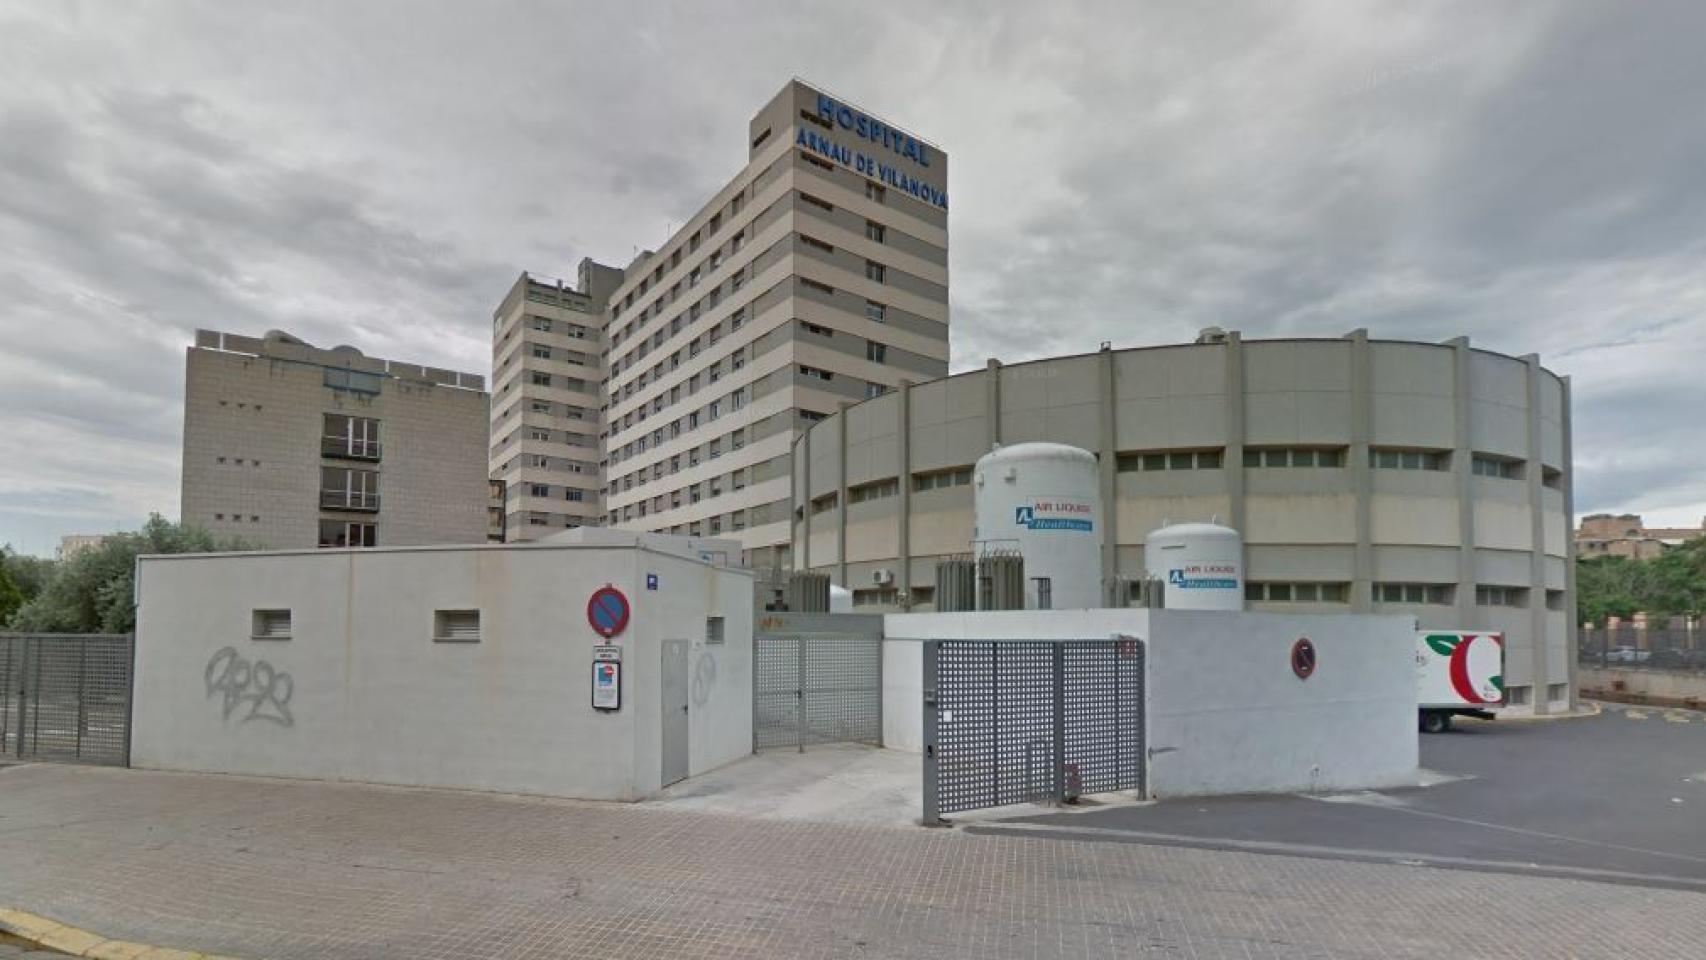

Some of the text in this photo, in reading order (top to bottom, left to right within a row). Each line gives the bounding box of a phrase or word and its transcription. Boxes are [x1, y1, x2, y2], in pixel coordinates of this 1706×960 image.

[817, 93, 929, 167] HOSPITAL
[796, 127, 949, 209] ARNAU DE VILANOVA
[1034, 503, 1052, 512] AIR
